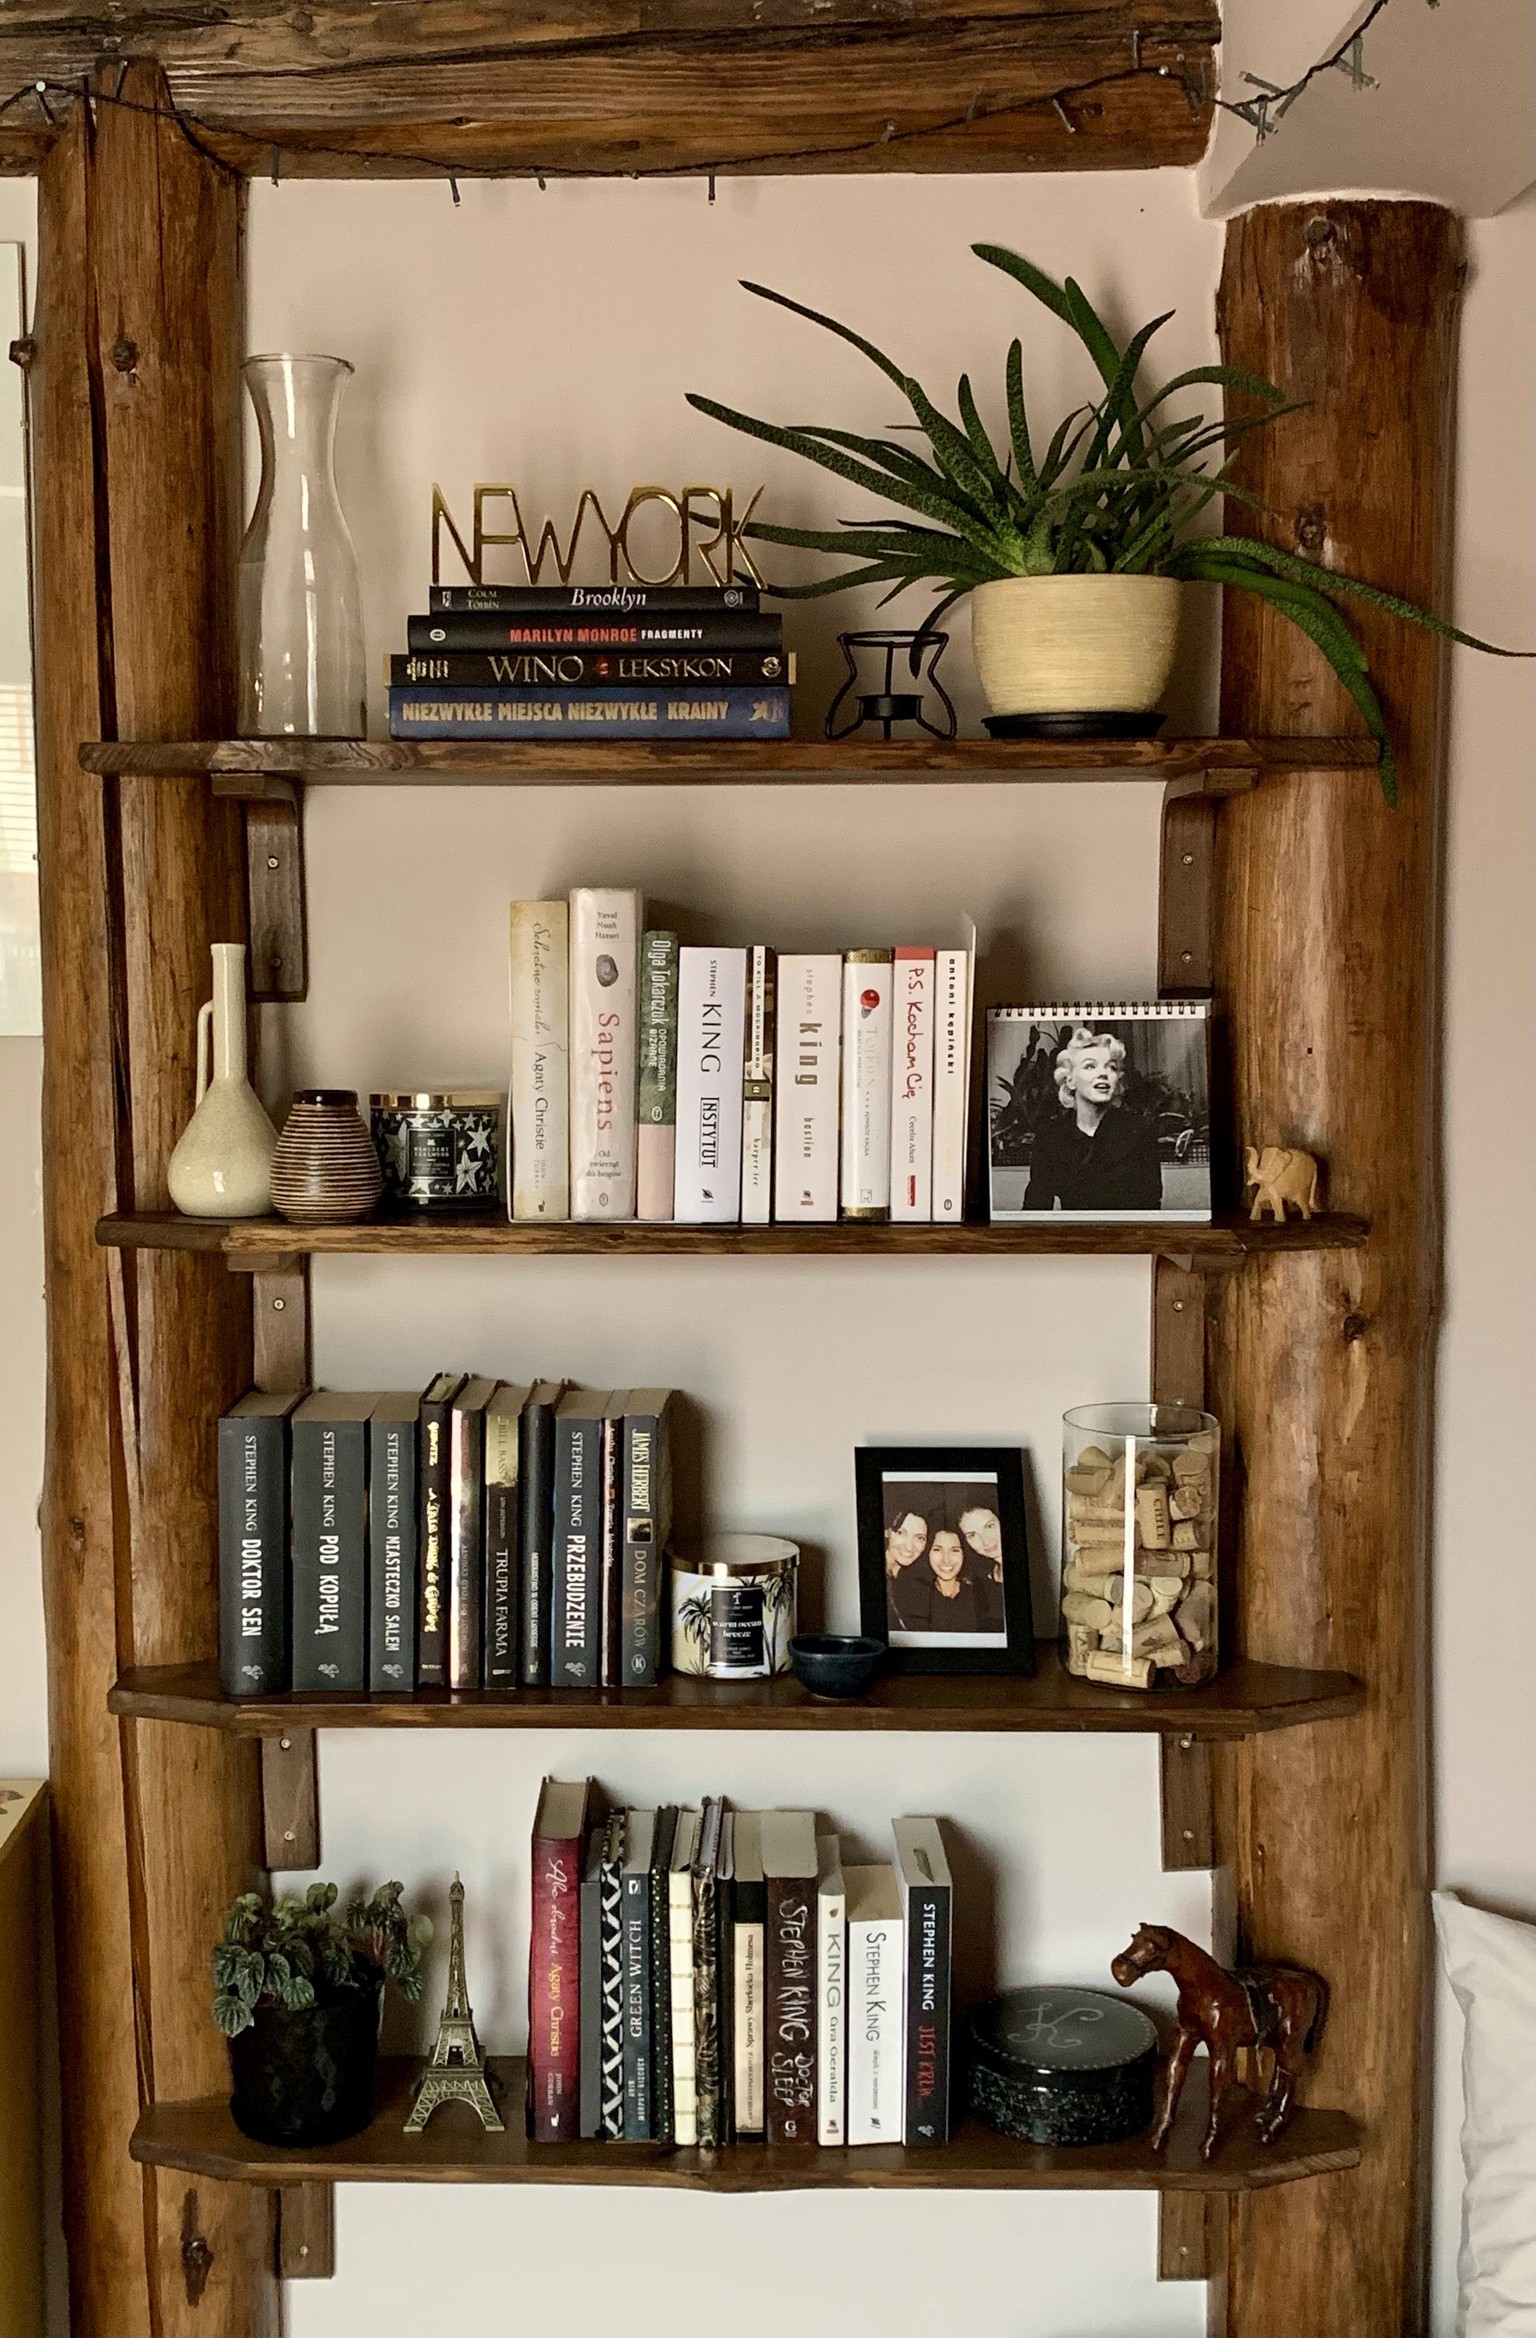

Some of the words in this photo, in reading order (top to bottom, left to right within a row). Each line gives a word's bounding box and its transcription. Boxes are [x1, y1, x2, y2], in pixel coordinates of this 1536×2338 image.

[571, 588, 647, 611] Brooklyn
[510, 628, 573, 643] MARILYN
[577, 628, 637, 642] MONROE
[641, 629, 703, 639] FRAGMENTY
[488, 655, 584, 682] WINO
[618, 658, 733, 678] LEKSYKON
[402, 703, 492, 722] NIEZWYKŁE
[498, 703, 562, 721] MIEJSCA
[568, 702, 657, 721] NIEZWYKŁE
[668, 702, 728, 720] KRAINY
[648, 940, 671, 966] Olga
[756, 955, 761, 966] TO
[650, 970, 671, 1025] Tokarczuk
[805, 969, 814, 1014] stephen
[908, 968, 923, 995] P.S.
[648, 1028, 658, 1068] BIZARNE
[700, 1004, 722, 1073] KING
[795, 1023, 822, 1086] king
[865, 1027, 878, 1087] TOLKIEN
[907, 1001, 923, 1070] Kocham
[946, 1013, 955, 1074] kępiński
[532, 1052, 548, 1093] Agaty
[591, 1012, 620, 1131] Sapiens
[901, 1073, 923, 1099] Cię
[535, 1097, 548, 1150] Christie
[699, 1097, 720, 1168] INSTYTUT
[803, 1117, 814, 1158] bastion
[751, 1138, 761, 1170] harper
[324, 1431, 334, 1488] STEPHEN
[497, 1424, 507, 1447] BILL
[571, 1431, 582, 1488] STEPHEN
[631, 1429, 650, 1463] JAMES
[246, 1435, 257, 1492] STEPHEN
[388, 1433, 398, 1490] STEPHEN
[497, 1450, 507, 1475] BASS
[324, 1494, 334, 1526] KING
[388, 1494, 398, 1529] KING
[571, 1495, 583, 1527] KING
[631, 1464, 650, 1512] HERBERT
[245, 1499, 257, 1532] KING
[242, 1539, 261, 1599] DOKTOR
[320, 1535, 338, 1564] POD
[386, 1536, 400, 1608] MIASTECZKO
[634, 1549, 646, 1583] DOM
[496, 1549, 508, 1603] TRUPIA
[565, 1534, 585, 1648] PRZEBUDZENIE
[242, 1607, 262, 1636] SEN
[314, 1574, 339, 1634] KOPUŁĄ
[633, 1589, 648, 1648] CZARÓW
[386, 1614, 400, 1651] SALEM
[496, 1606, 509, 1657] FARMA
[629, 1921, 642, 1977] WITCH
[778, 1900, 807, 1979] STEPHEN
[923, 1903, 936, 1968] STEPHEN
[549, 1963, 562, 2001] Agaty
[827, 1933, 841, 2008] KING
[923, 1973, 935, 2010] KING
[550, 2006, 564, 2057] Christie
[629, 1983, 642, 2038] GREEN
[777, 1986, 810, 2041] KING
[829, 2017, 838, 2042] Gra
[771, 2052, 795, 2107] SLEEP
[795, 2053, 813, 2107] DOCTOR
[829, 2046, 838, 2103] Geralda
